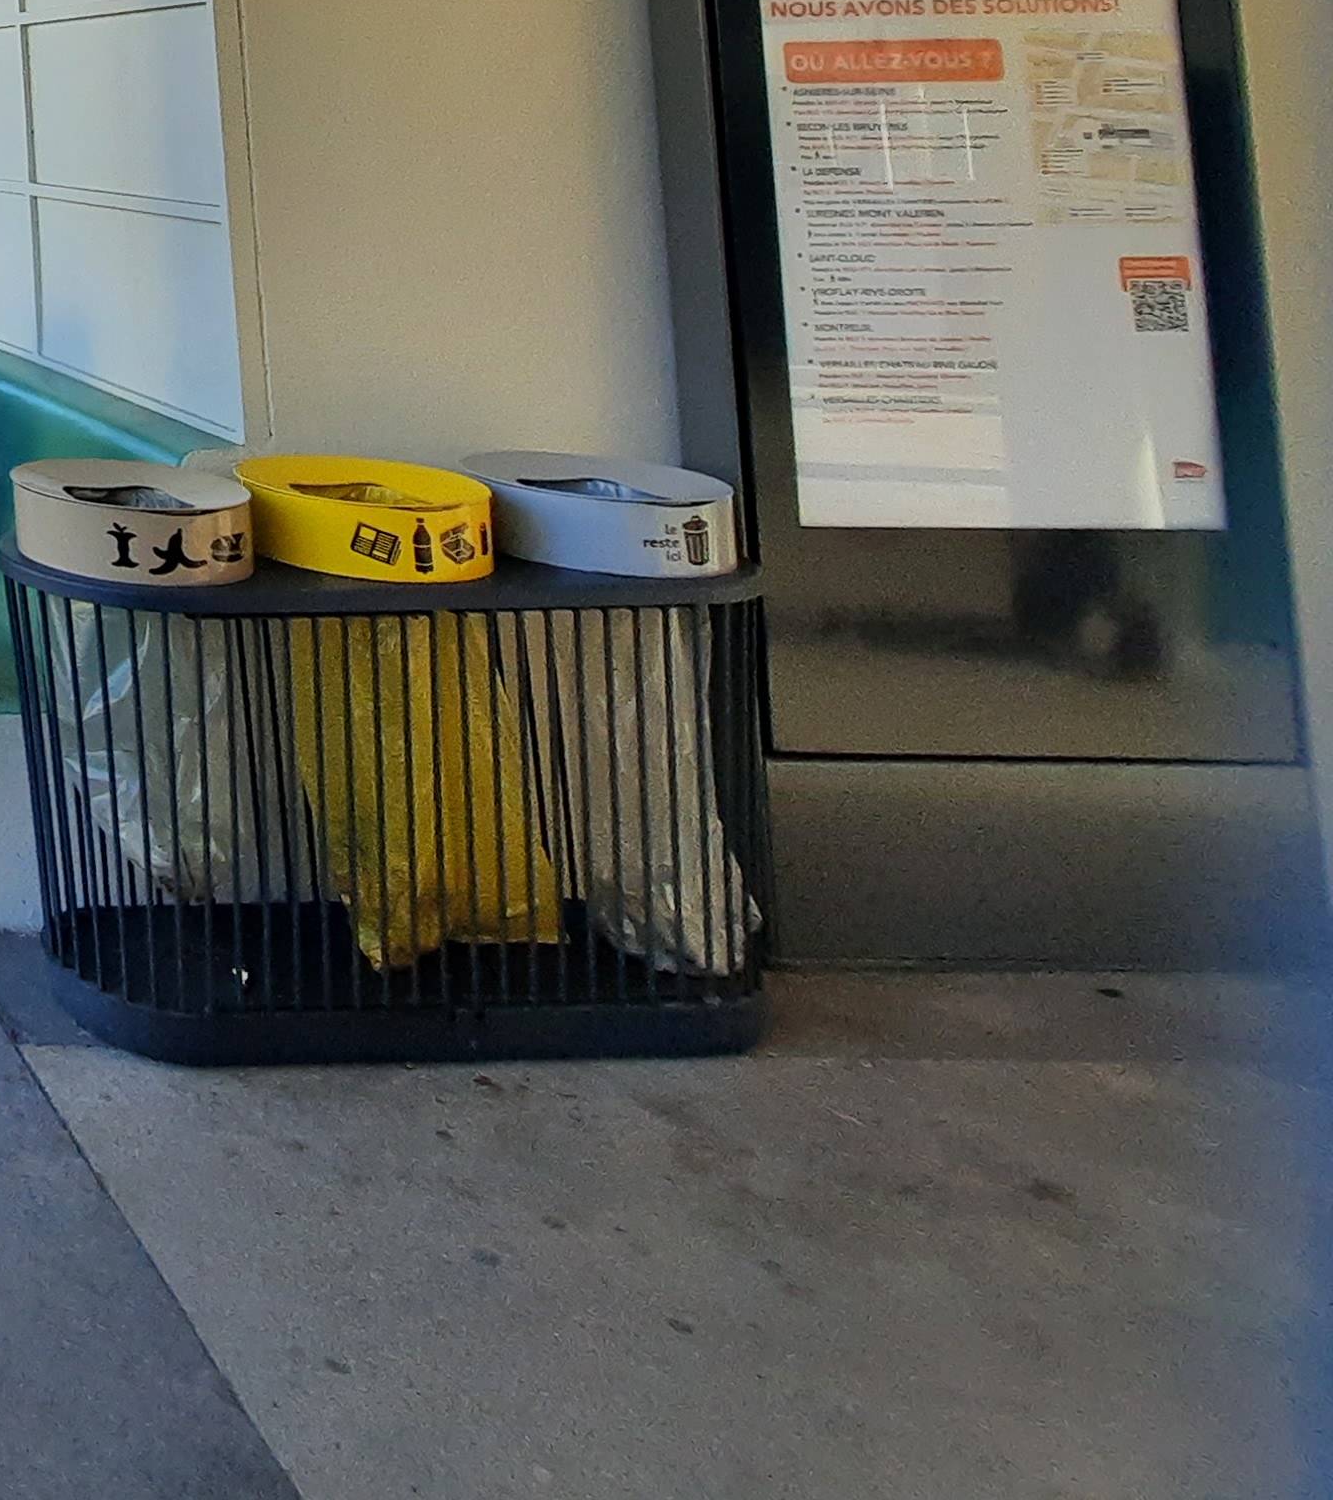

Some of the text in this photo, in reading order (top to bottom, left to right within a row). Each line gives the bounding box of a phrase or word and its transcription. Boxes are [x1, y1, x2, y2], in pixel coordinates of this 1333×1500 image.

[770, 1, 837, 18] NOUS
[844, 0, 926, 17] AVONS
[834, 50, 973, 71] ALLEZ-VOUS
[664, 524, 677, 535] le
[643, 538, 679, 548] reste
[666, 551, 681, 561] ici
